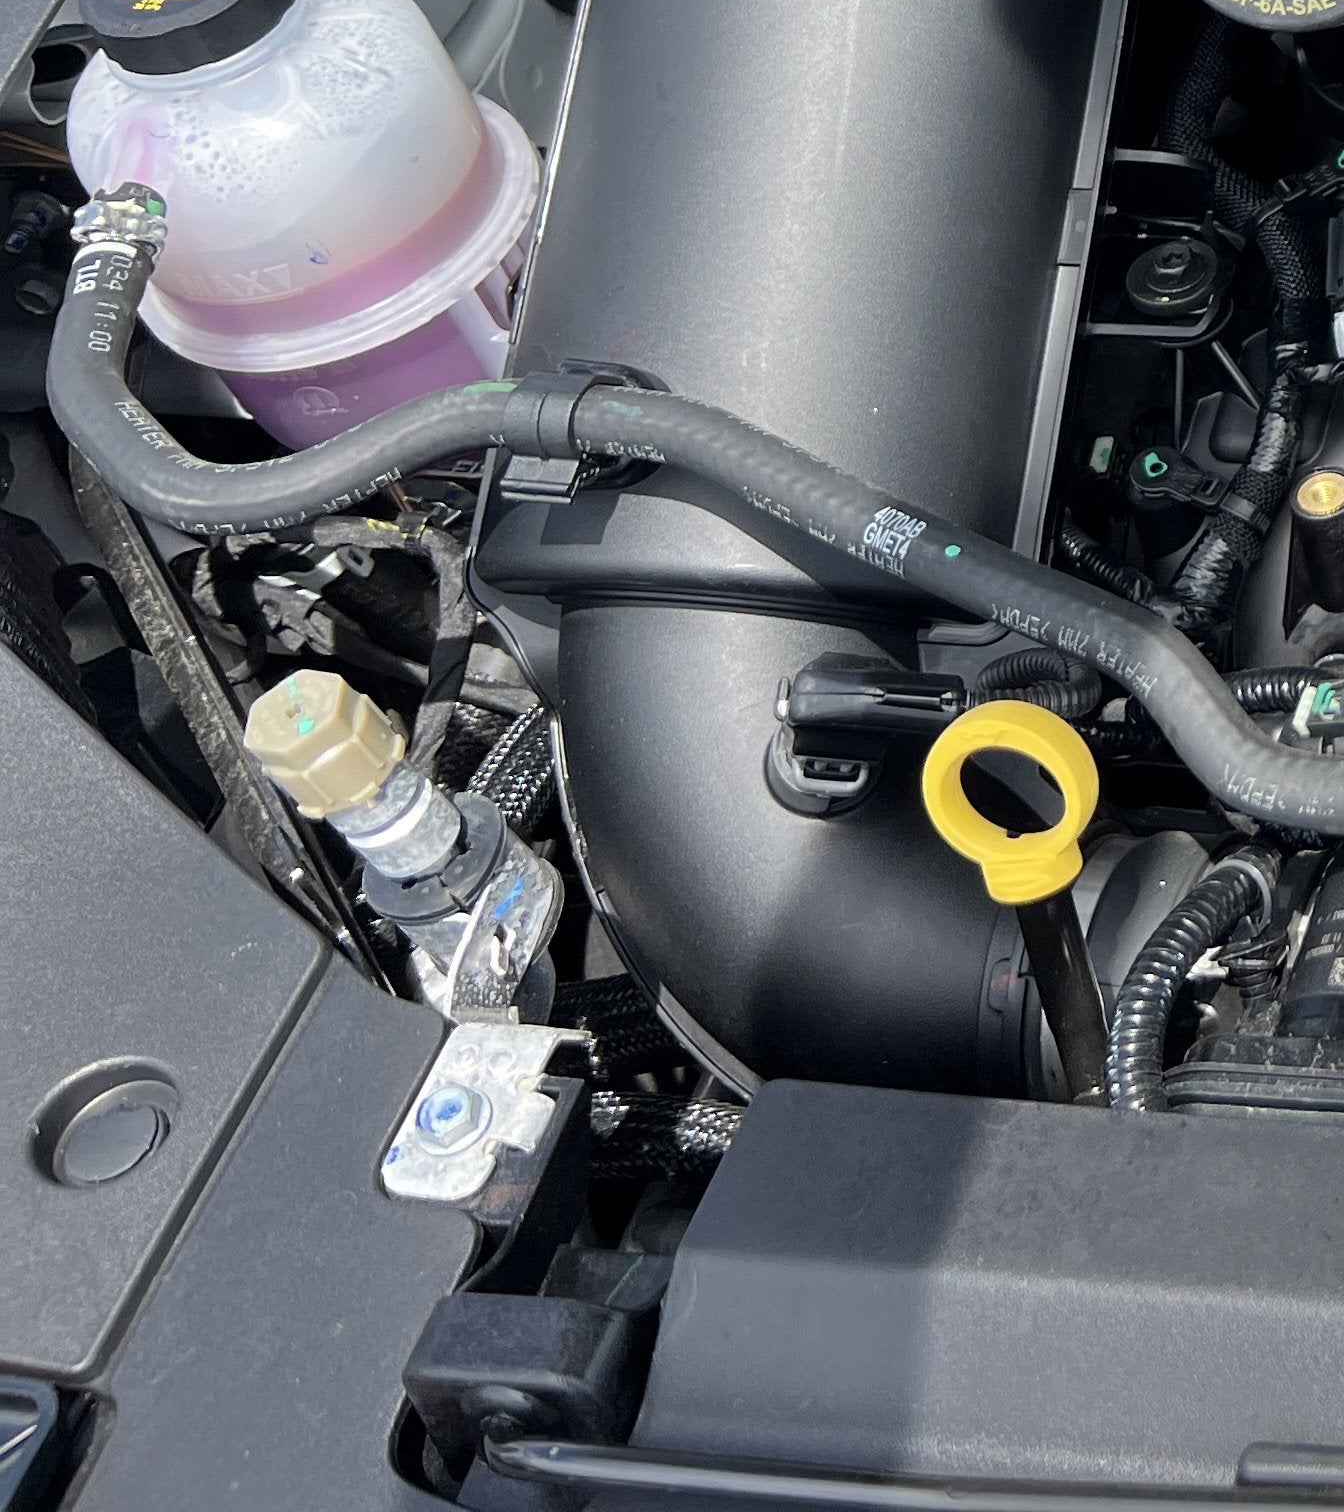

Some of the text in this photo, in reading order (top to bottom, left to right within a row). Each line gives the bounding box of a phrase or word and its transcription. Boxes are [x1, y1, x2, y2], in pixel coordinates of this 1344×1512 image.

[87, 300, 121, 353] 11:00
[862, 521, 913, 560] GMET4
[873, 505, 928, 540] 4070AB
